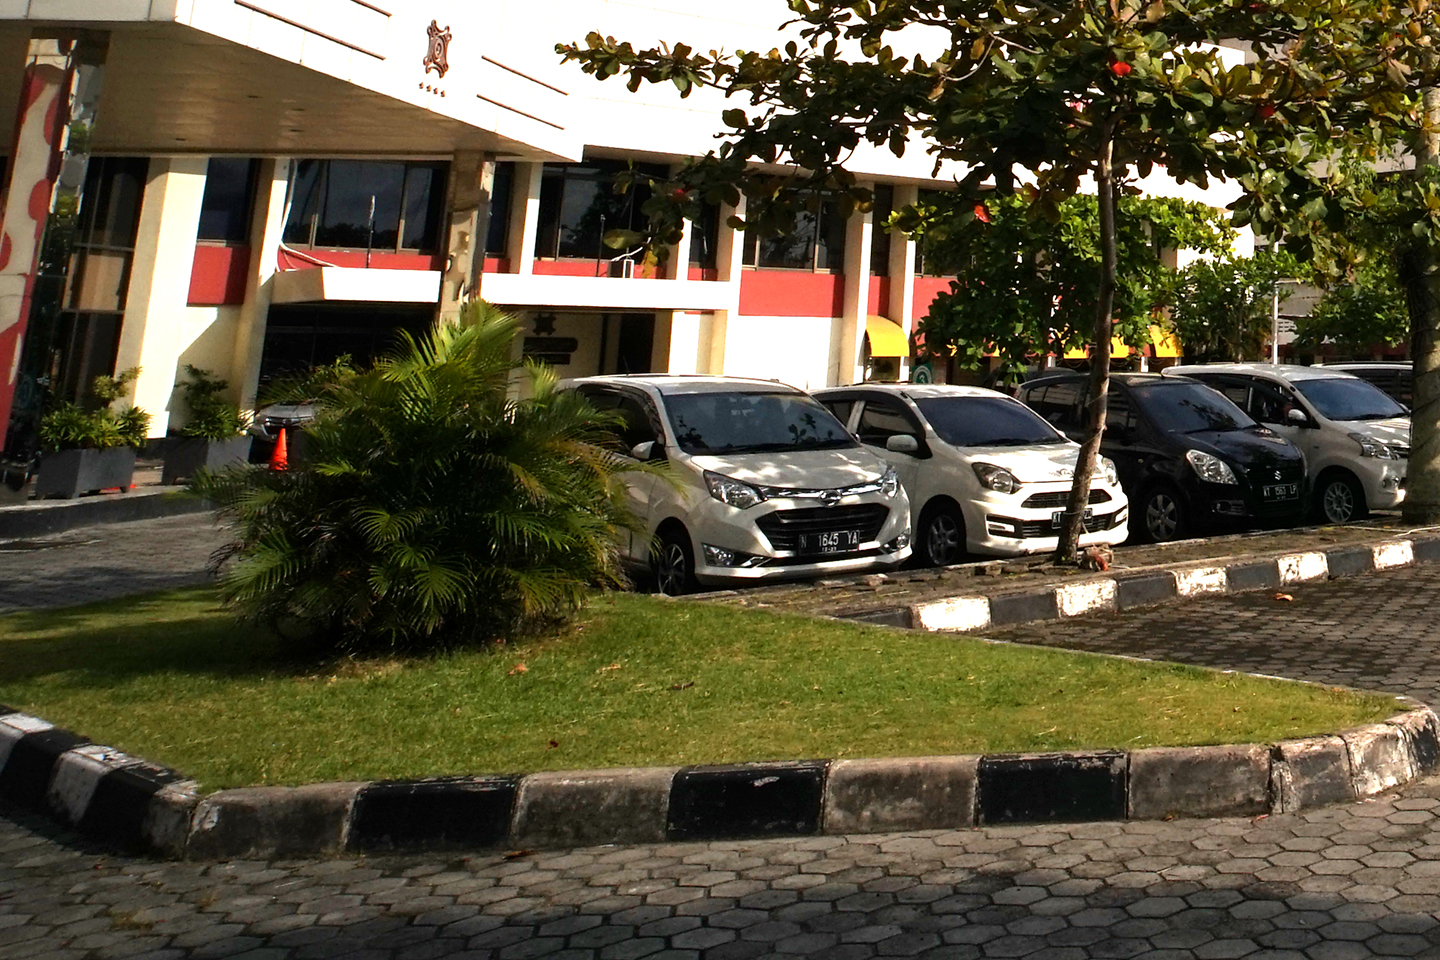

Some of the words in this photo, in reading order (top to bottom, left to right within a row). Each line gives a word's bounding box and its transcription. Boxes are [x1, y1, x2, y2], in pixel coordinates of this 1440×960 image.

[801, 535, 807, 548] N
[818, 533, 839, 547] 1645
[847, 531, 858, 544] YA
